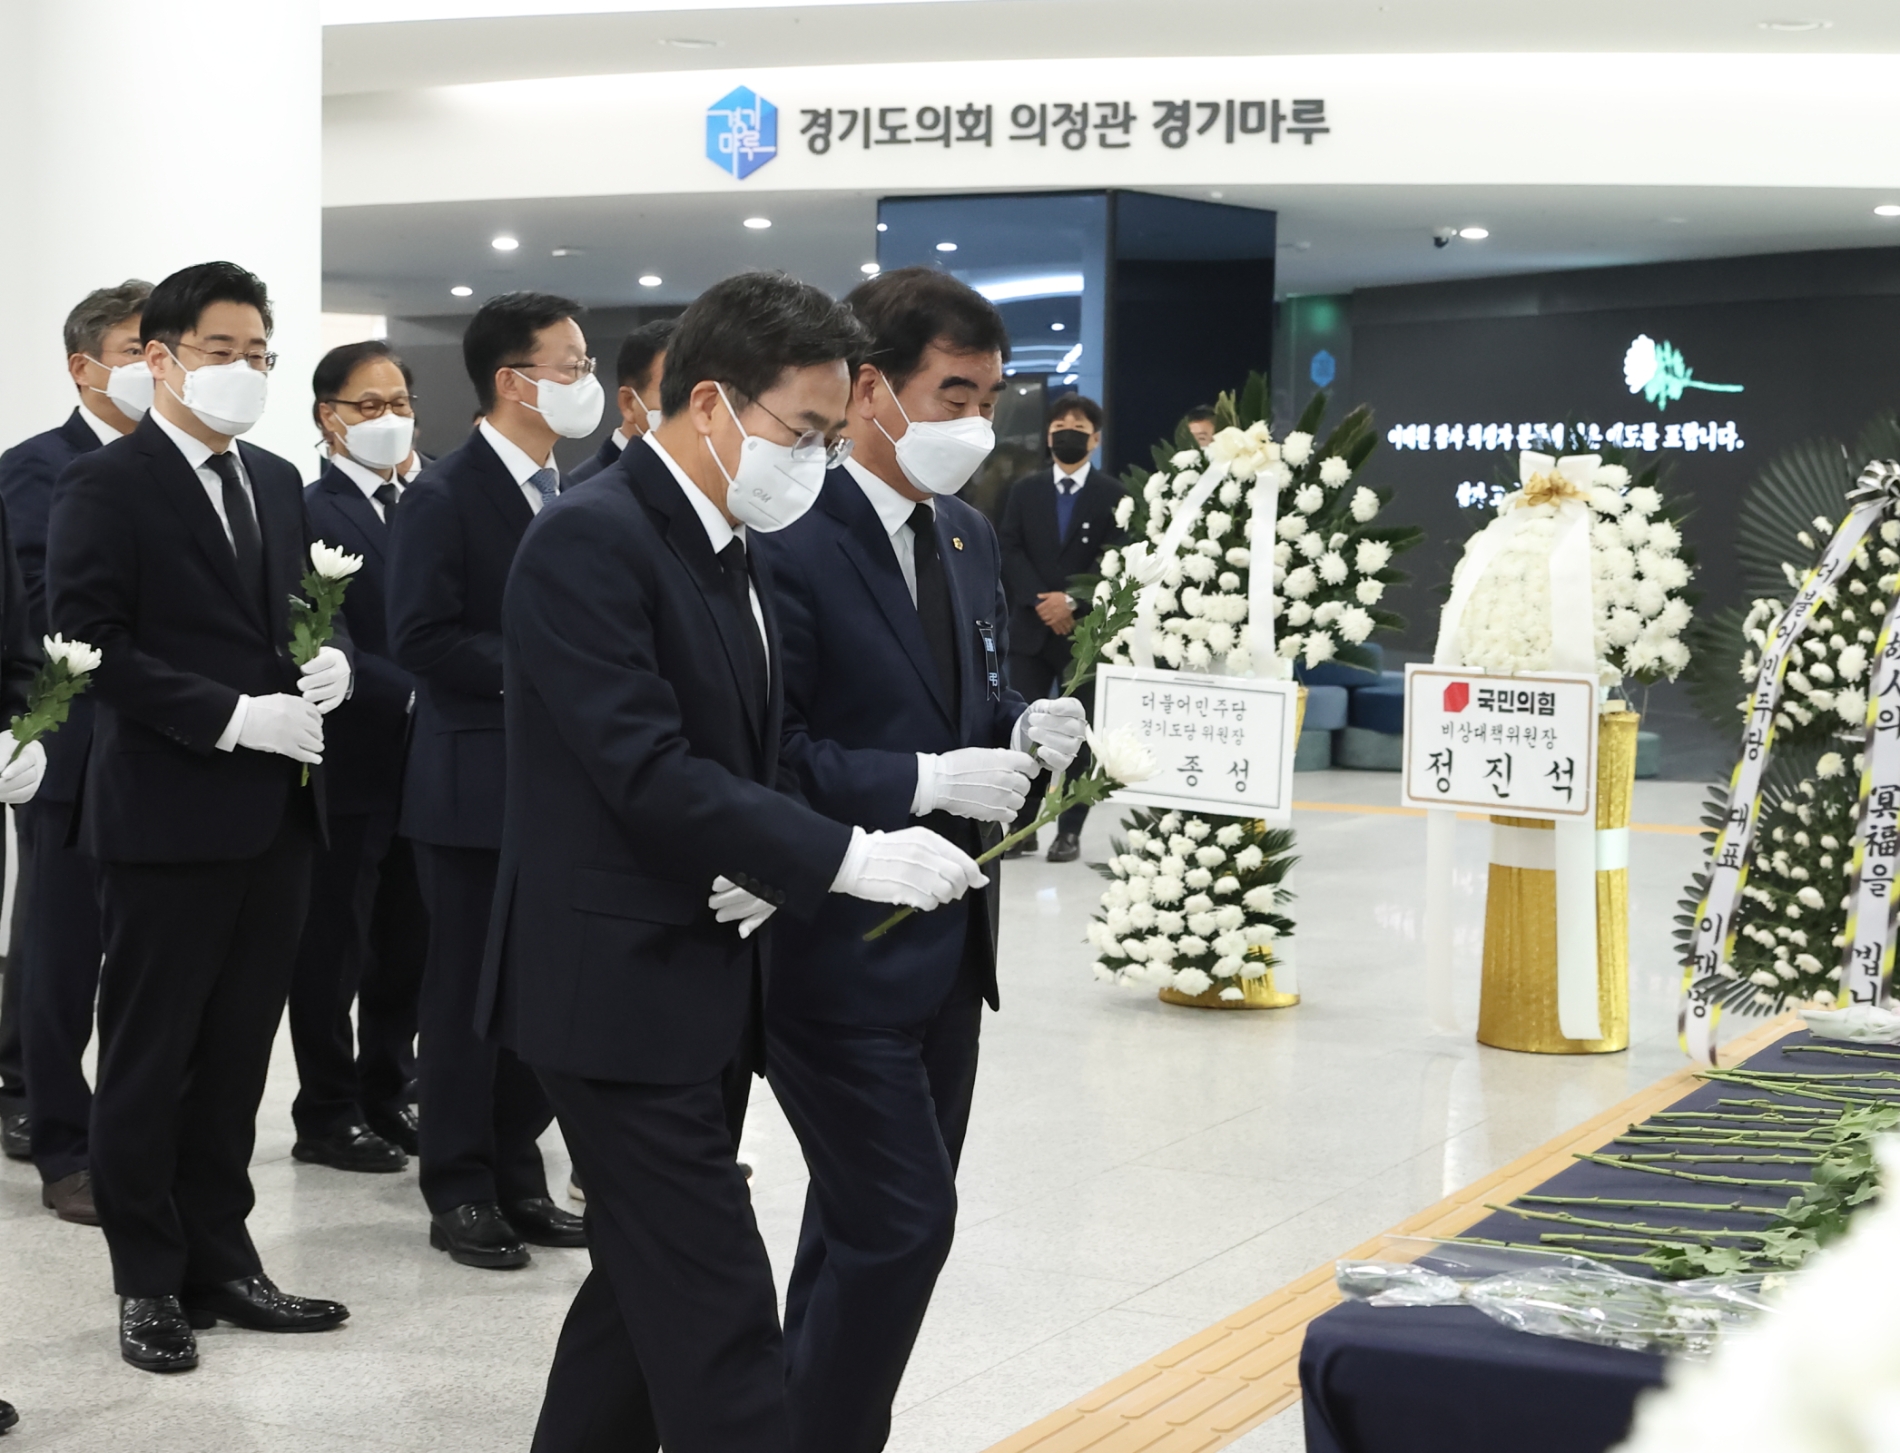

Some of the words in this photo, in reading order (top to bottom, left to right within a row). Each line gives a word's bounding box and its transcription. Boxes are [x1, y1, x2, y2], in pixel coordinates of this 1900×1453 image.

[799, 101, 993, 155] 경기도의회
[1007, 101, 1138, 151] 의정관
[1152, 98, 1331, 150] 경기마루
[1477, 688, 1556, 717] 국민의힘
[1715, 802, 1750, 870] 대표
